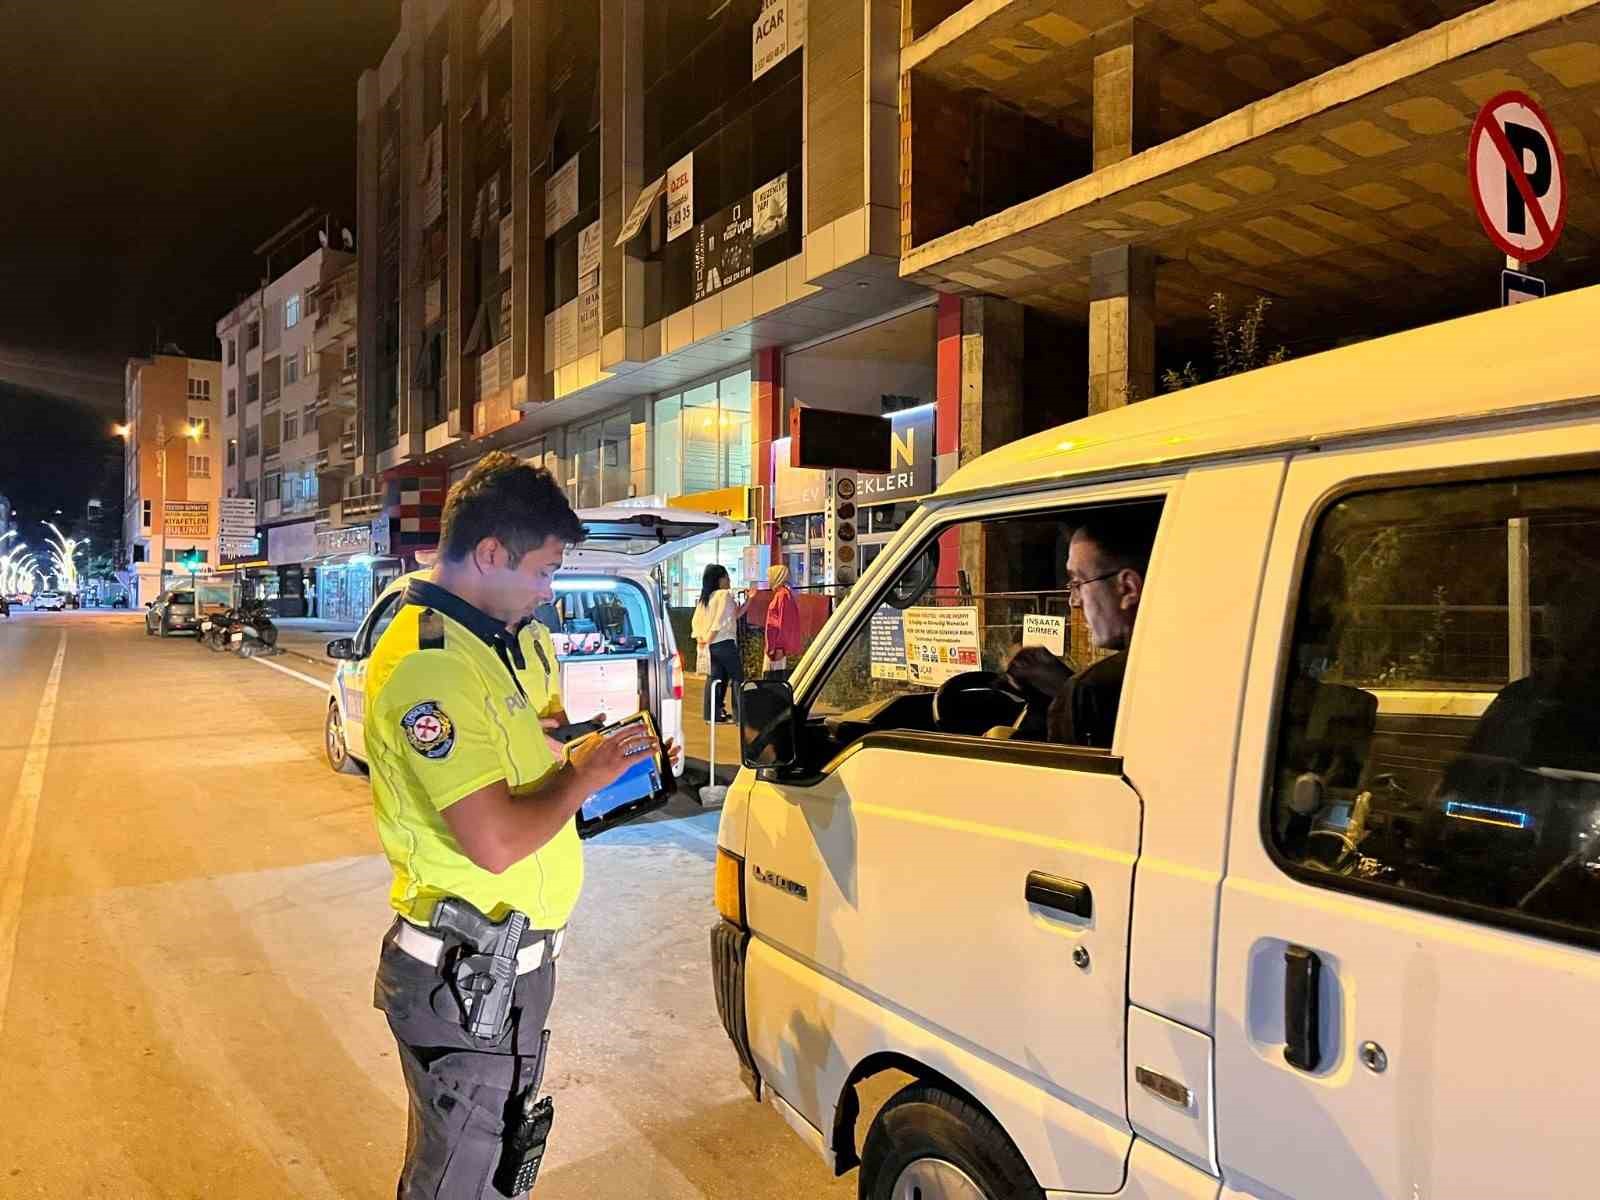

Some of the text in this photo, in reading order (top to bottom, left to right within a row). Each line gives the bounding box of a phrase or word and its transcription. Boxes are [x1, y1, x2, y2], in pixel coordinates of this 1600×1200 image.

[755, 8, 784, 44] ACAR
[1504, 121, 1552, 235] P
[857, 471, 914, 495] EKLERİ
